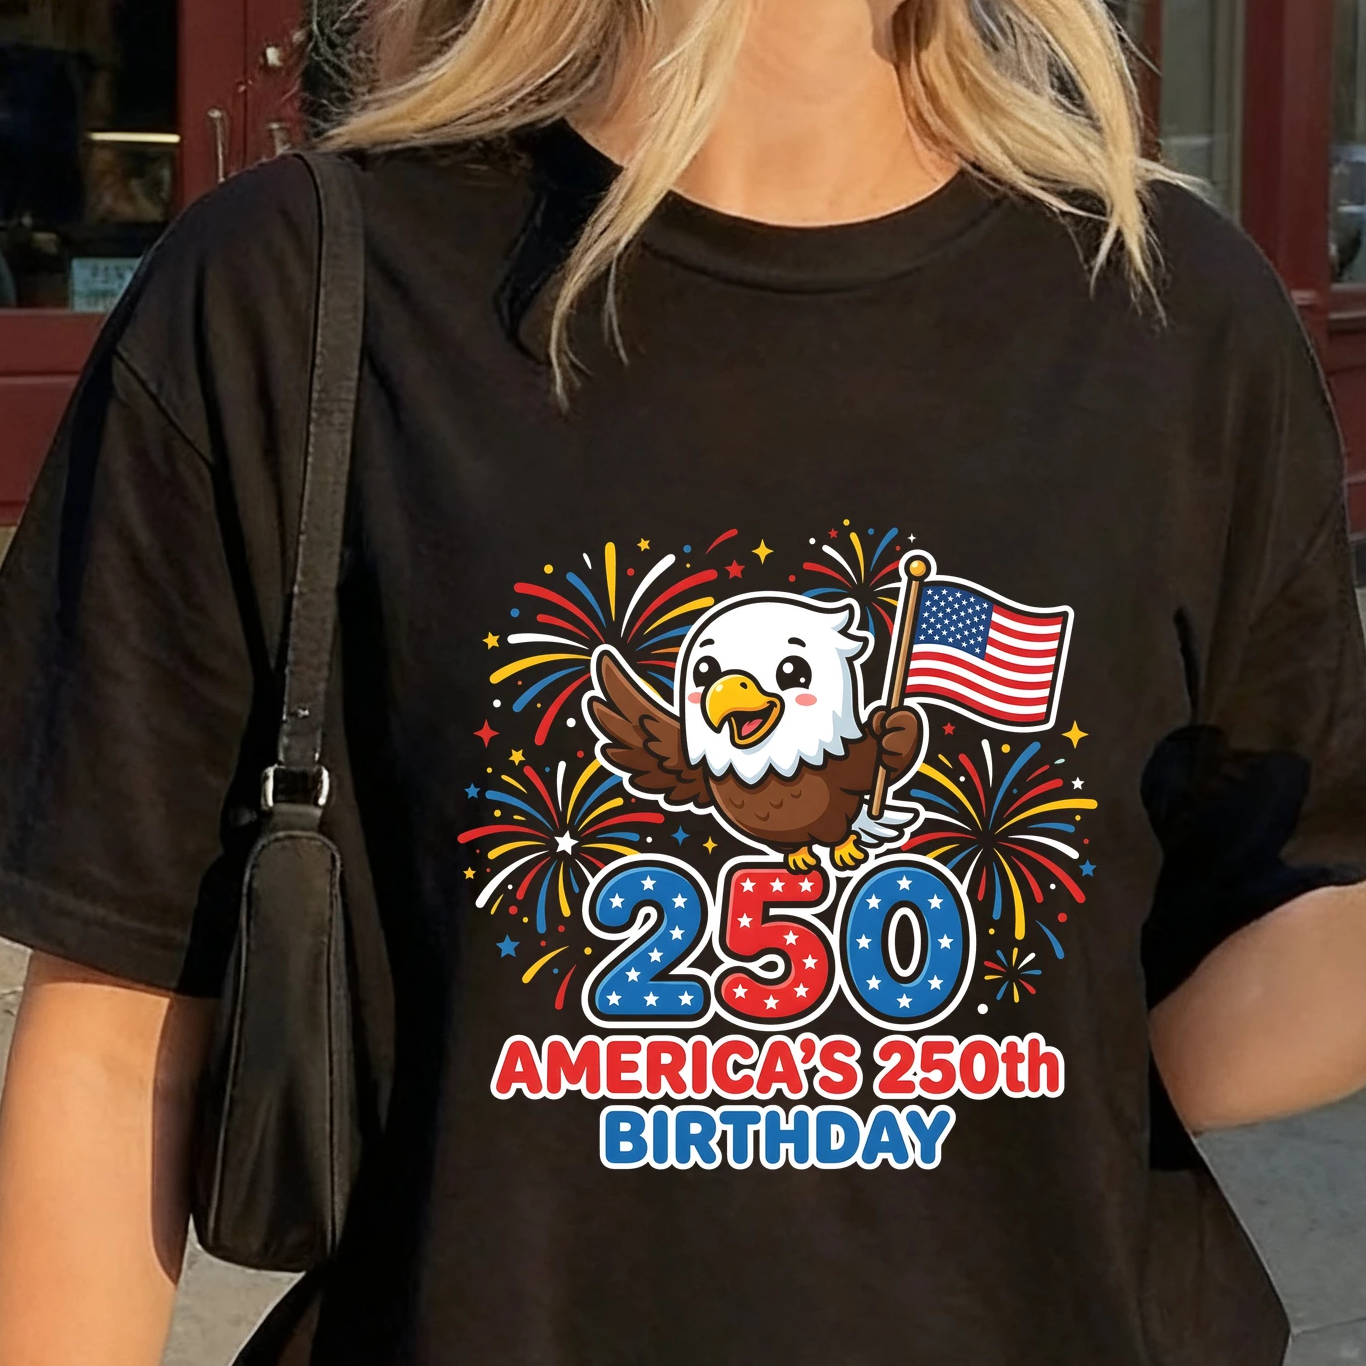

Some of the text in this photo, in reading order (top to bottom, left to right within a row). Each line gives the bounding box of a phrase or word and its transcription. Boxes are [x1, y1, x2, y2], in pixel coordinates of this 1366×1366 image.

[589, 861, 969, 1023] 250
[493, 1035, 1062, 1097] AMERICA'S 250th
[603, 1108, 953, 1167] BIRTHDAY
